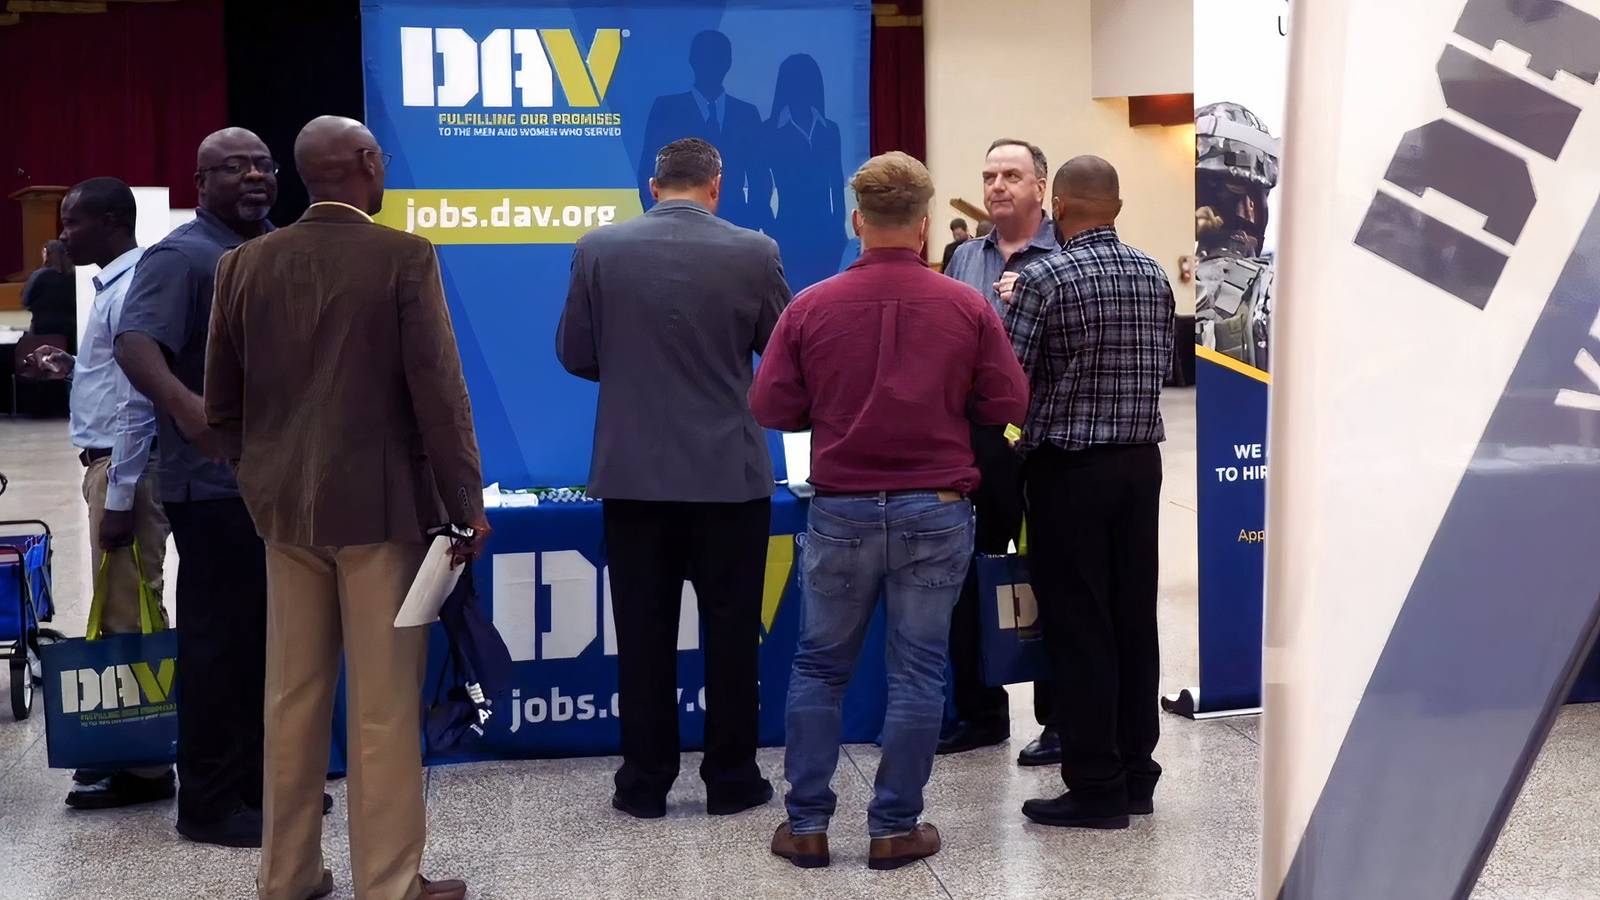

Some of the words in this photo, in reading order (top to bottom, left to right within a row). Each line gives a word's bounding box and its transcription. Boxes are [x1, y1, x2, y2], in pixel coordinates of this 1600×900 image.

[401, 27, 622, 107] DAV
[438, 113, 516, 125] FULFILLING
[520, 113, 548, 125] OUR
[552, 113, 622, 125] PROMISES
[438, 127, 451, 136] TO
[453, 127, 471, 136] THE
[473, 127, 496, 136] MEN
[497, 127, 518, 136] AND
[520, 127, 559, 136] WOMEN
[559, 127, 583, 136] WHO
[584, 127, 622, 136] SERVED
[404, 197, 617, 234] jobs.dav.org
[1234, 443, 1262, 459] WE
[1215, 466, 1239, 482] TO
[61, 658, 176, 714] DAV
